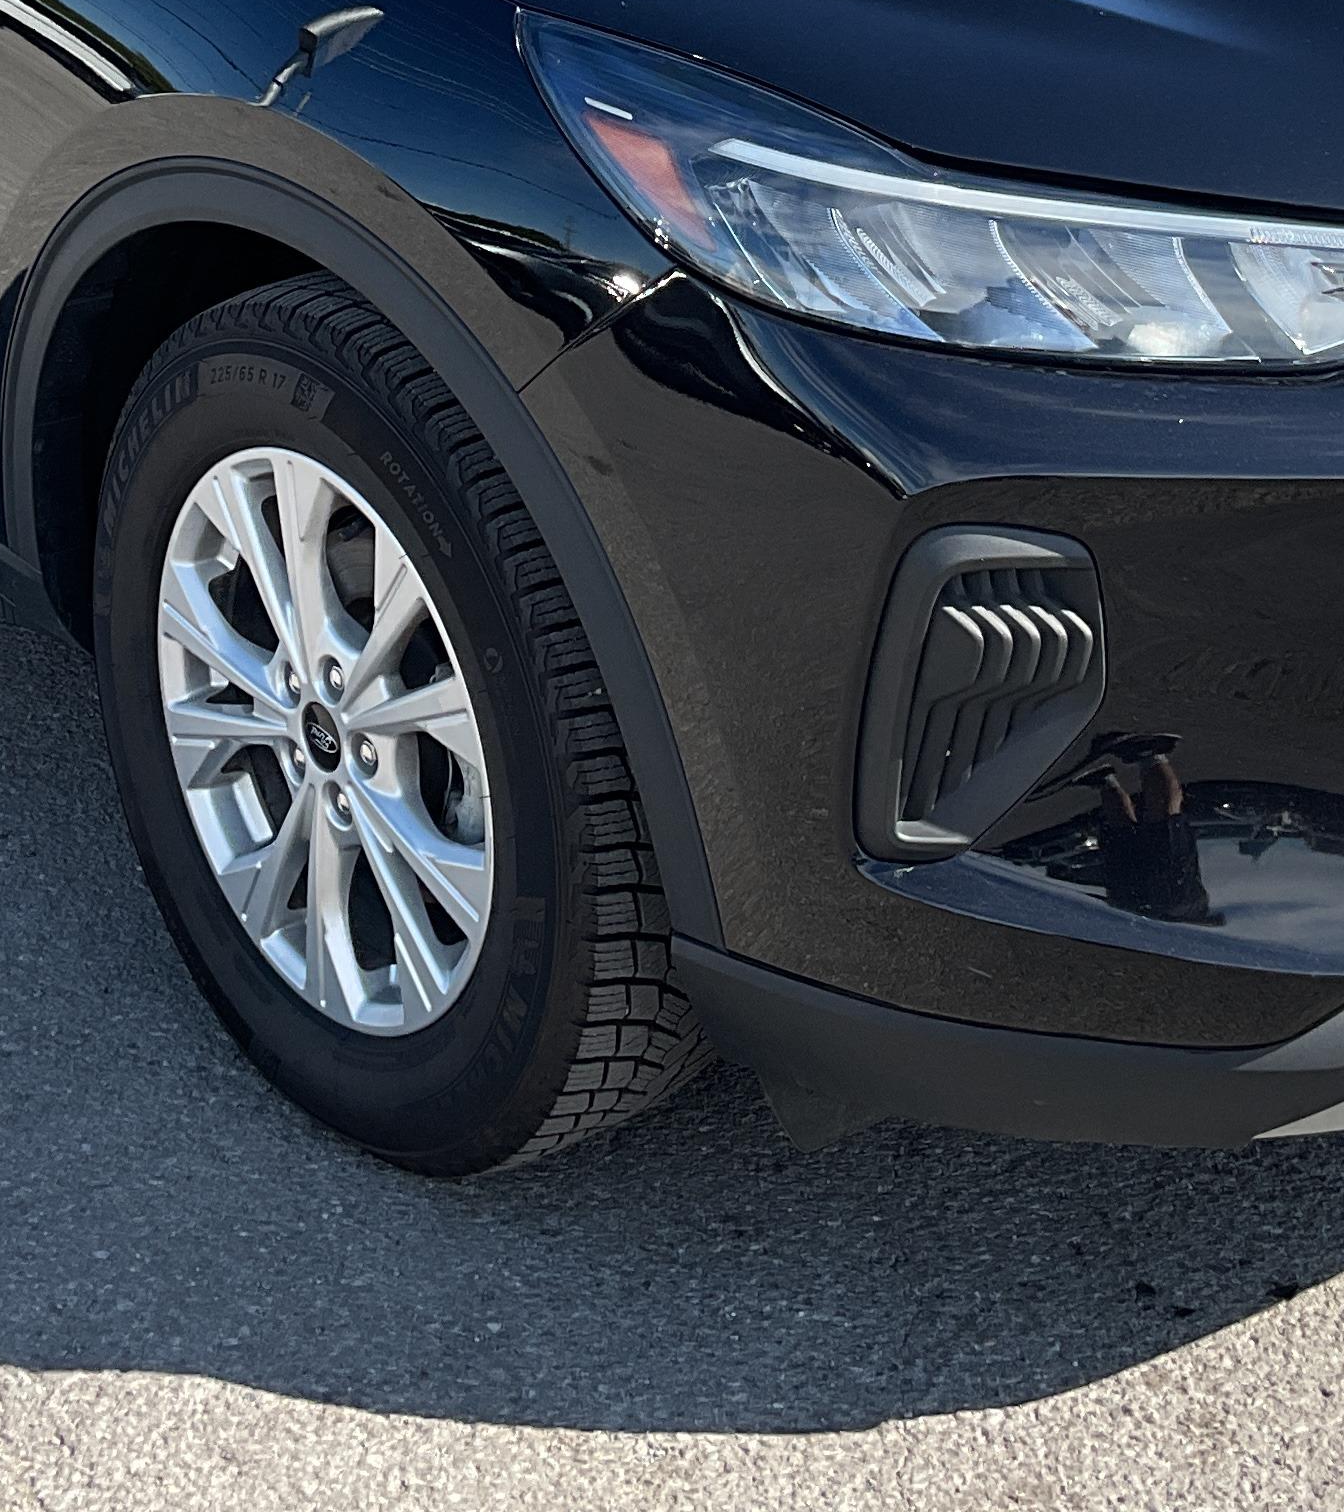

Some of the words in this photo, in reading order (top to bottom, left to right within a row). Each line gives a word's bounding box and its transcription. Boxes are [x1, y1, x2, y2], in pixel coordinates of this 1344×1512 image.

[208, 365, 255, 385] 225/65
[257, 366, 268, 385] R
[271, 371, 288, 391] 17
[101, 366, 194, 538] MICHELIN
[378, 450, 446, 539] ROTATION
